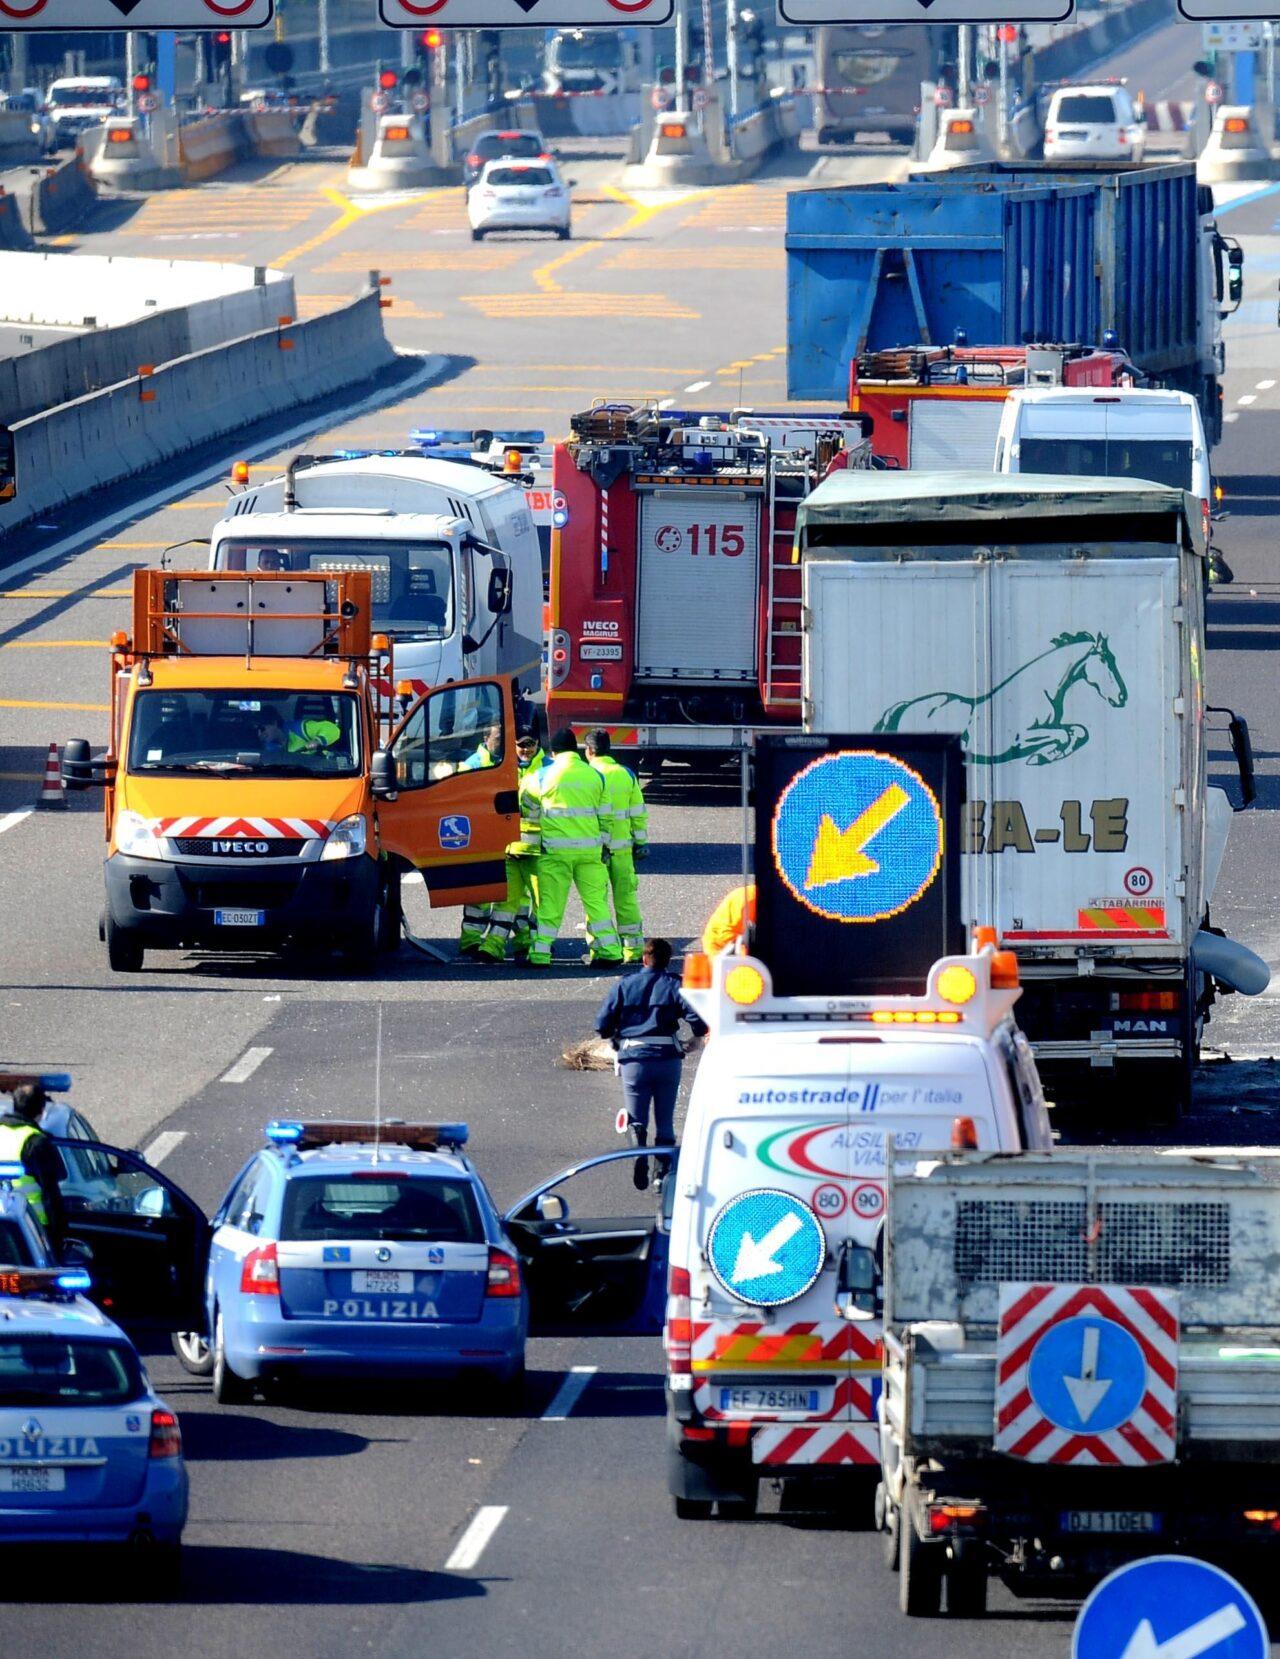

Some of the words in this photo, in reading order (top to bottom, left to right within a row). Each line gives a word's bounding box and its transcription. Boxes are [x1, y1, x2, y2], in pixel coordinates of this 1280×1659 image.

[687, 523, 745, 557] 115
[583, 621, 619, 630] IVECO
[212, 841, 269, 853] IVECO
[1131, 875, 1146, 887] 80
[1102, 899, 1162, 908] TABARRINI
[1114, 1021, 1167, 1032] MAN
[739, 1088, 860, 1104] autostrade
[880, 1091, 908, 1107] per
[818, 1194, 840, 1208] 80
[858, 1194, 879, 1208] 90
[323, 1300, 439, 1318] POLIZIA
